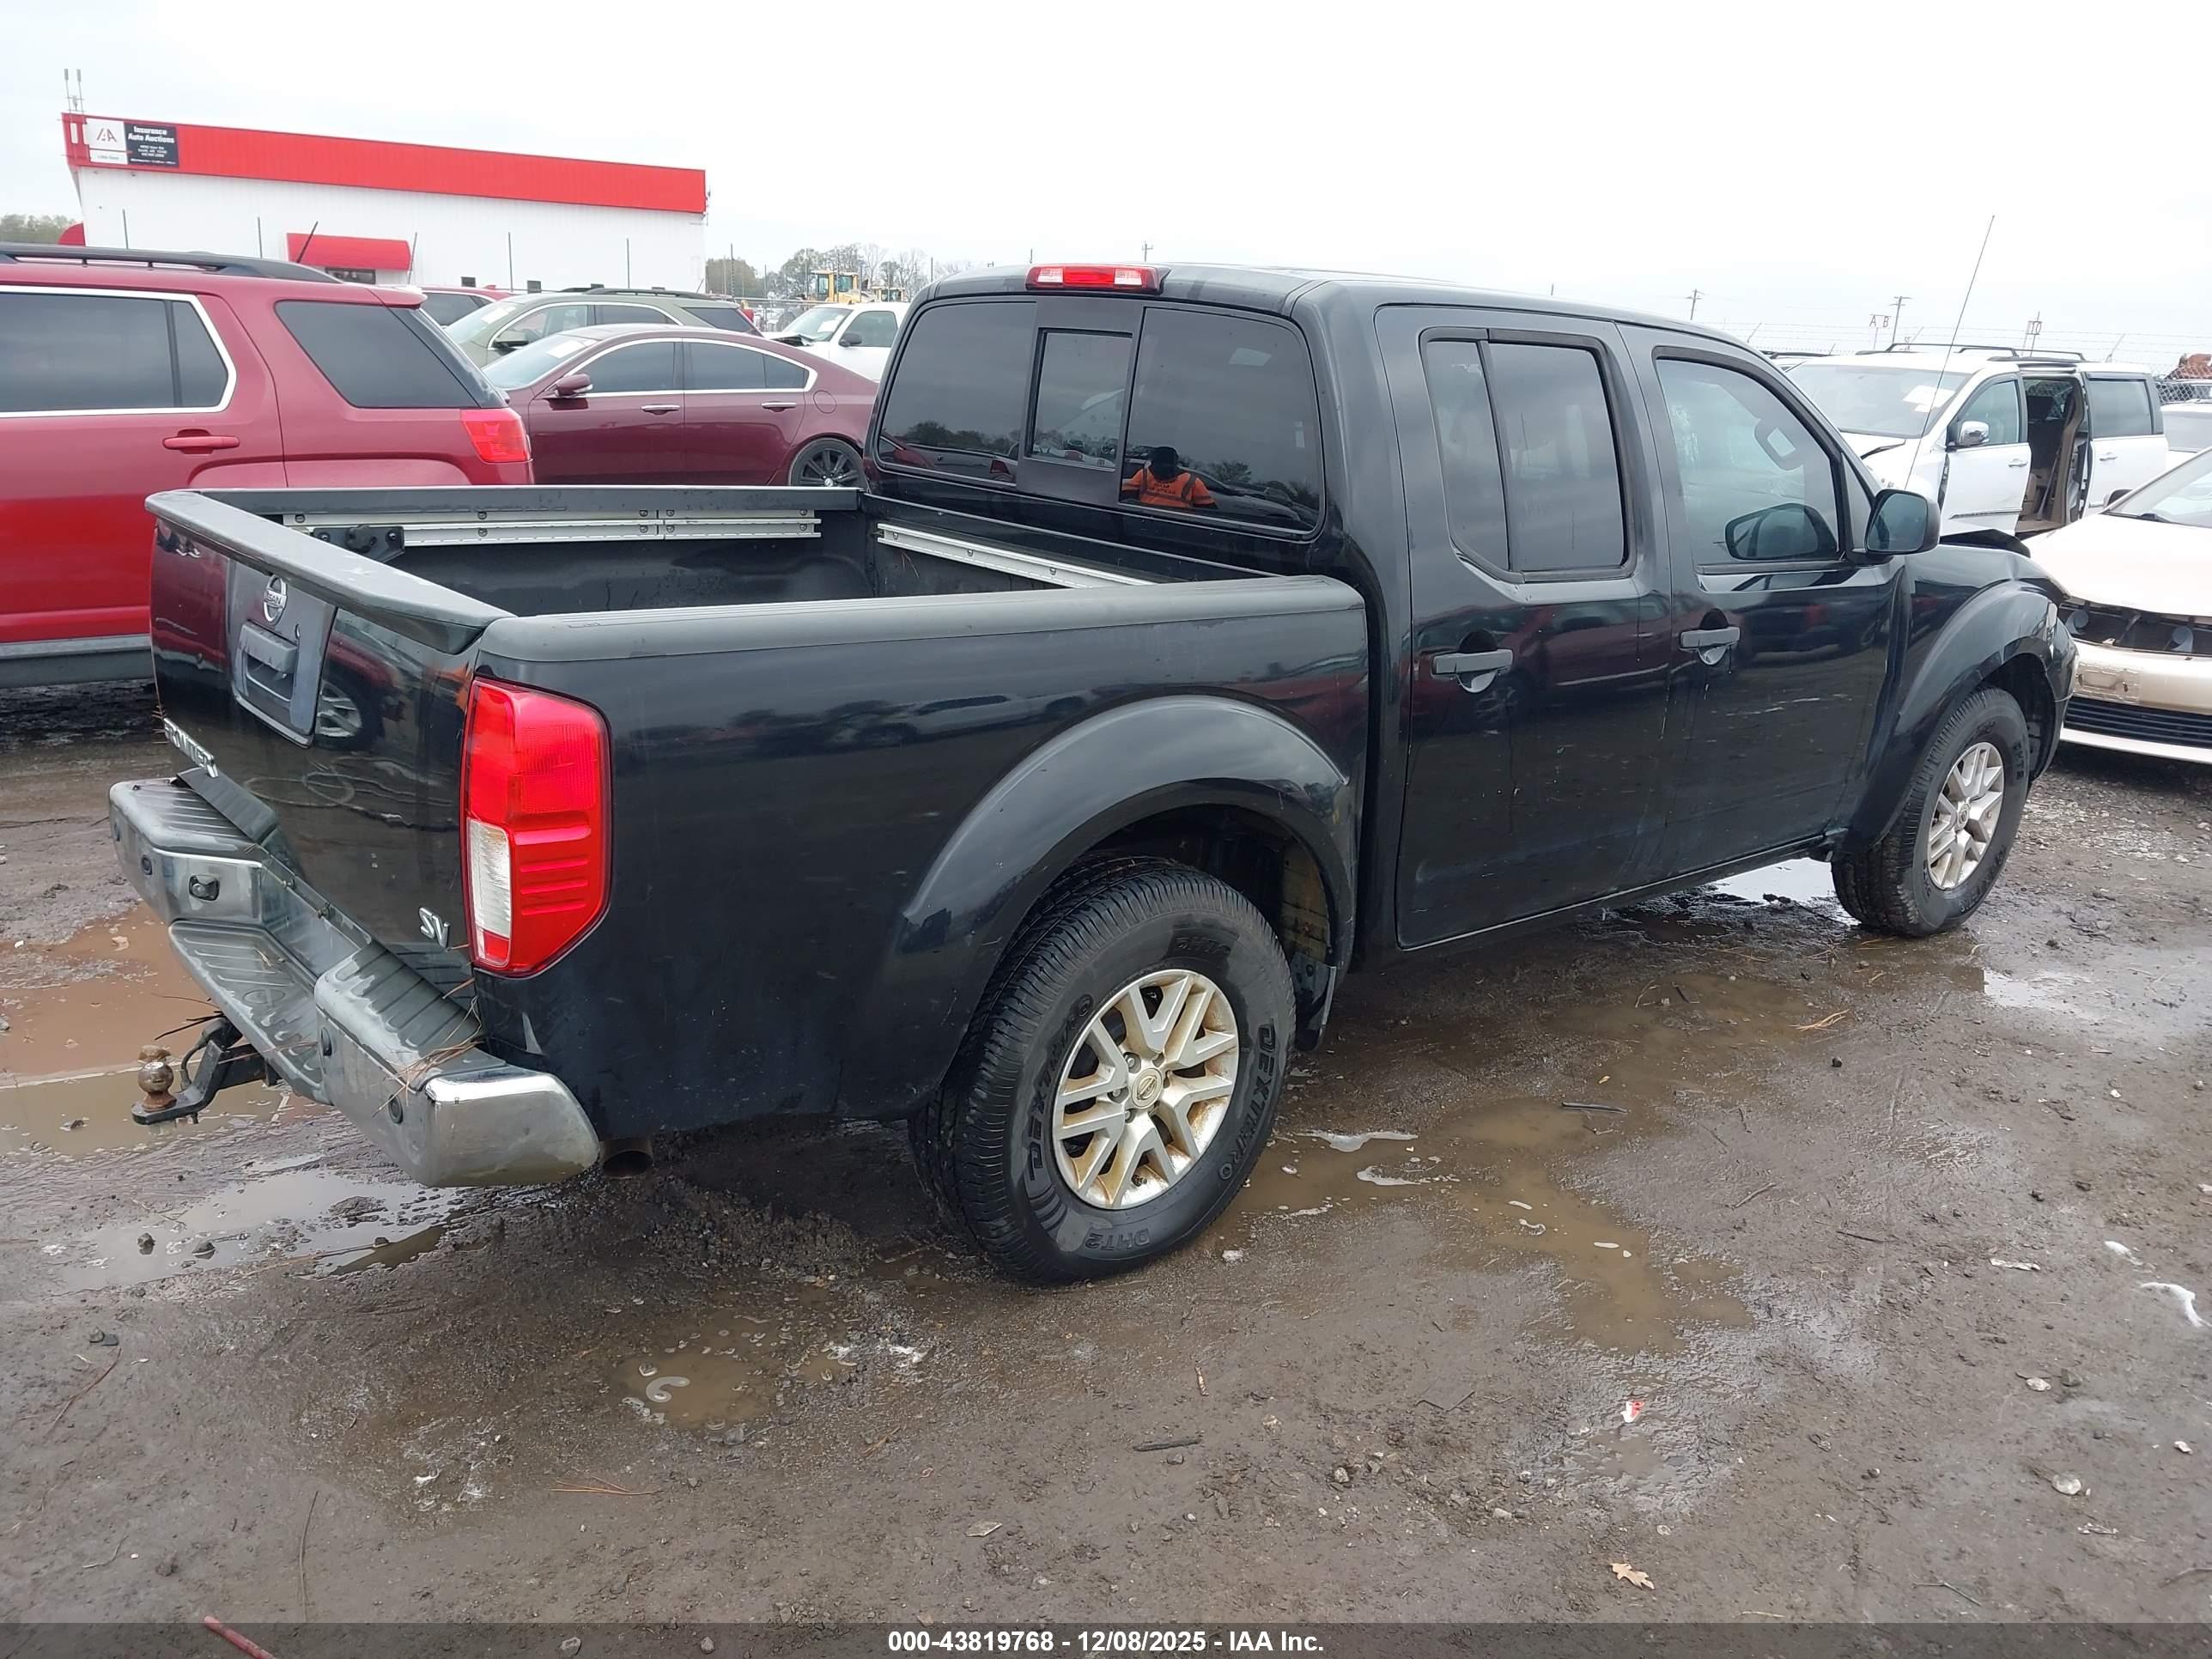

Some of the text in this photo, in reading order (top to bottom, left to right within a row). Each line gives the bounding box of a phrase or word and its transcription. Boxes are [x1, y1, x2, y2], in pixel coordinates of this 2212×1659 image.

[133, 125, 167, 136] Insurance
[128, 132, 174, 143] Auto Auctions
[418, 907, 451, 948] SV
